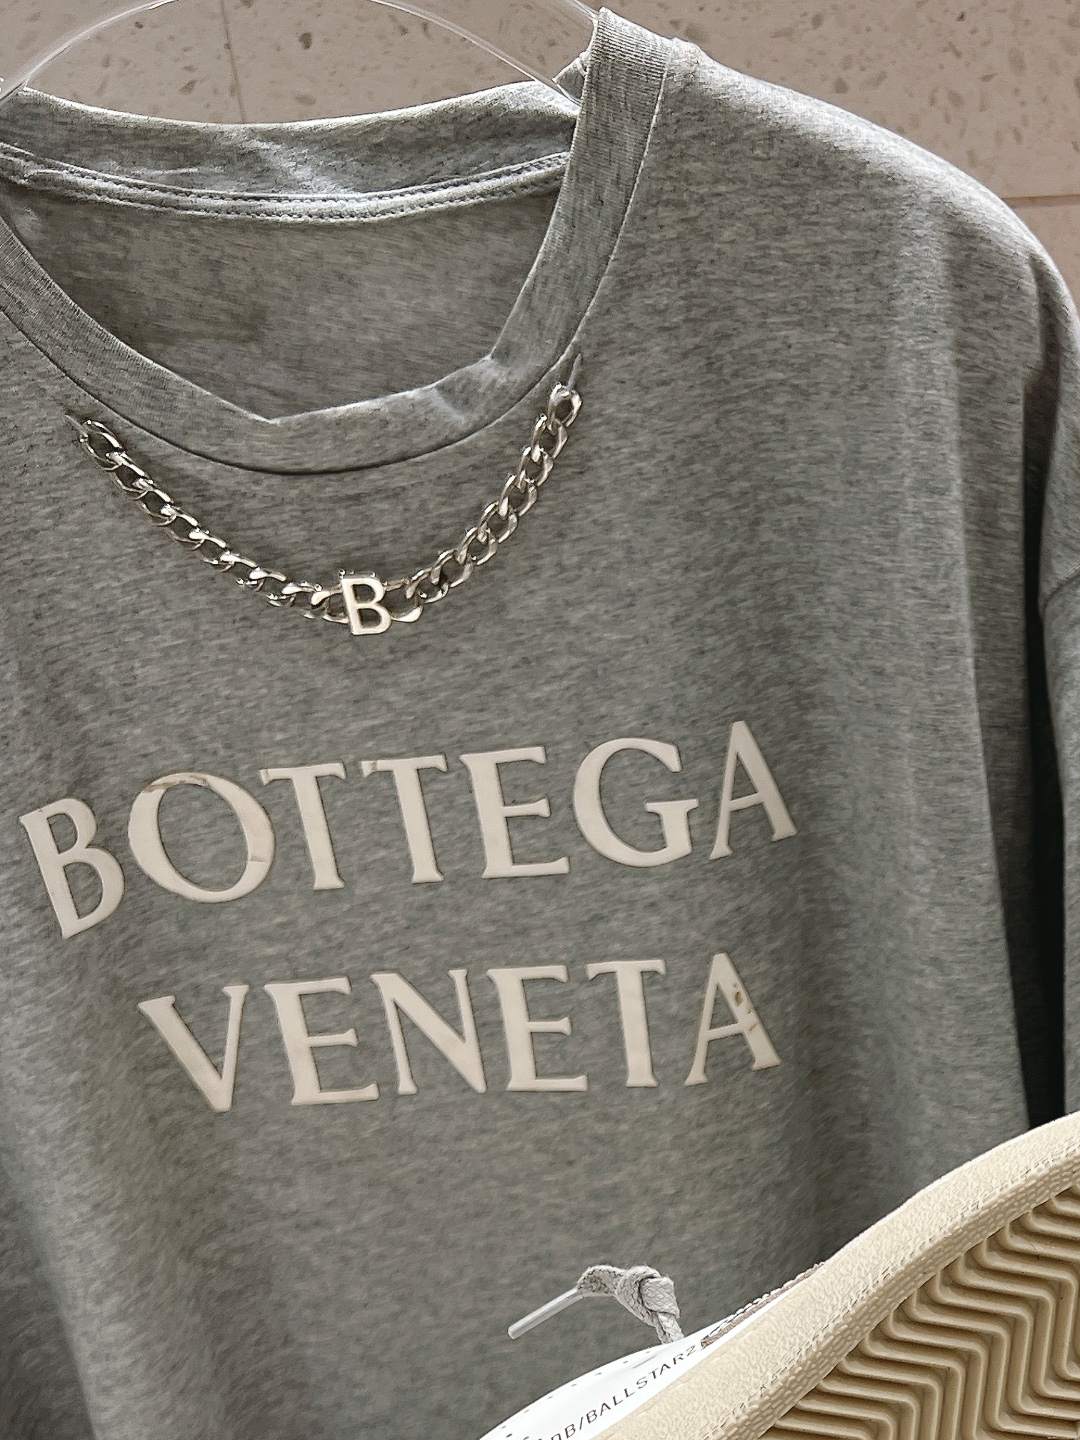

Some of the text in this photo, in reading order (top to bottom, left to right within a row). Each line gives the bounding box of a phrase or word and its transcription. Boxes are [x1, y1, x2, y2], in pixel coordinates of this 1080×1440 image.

[341, 577, 392, 635] B
[19, 721, 797, 940] BOTTEGA
[137, 952, 781, 1113] VENETA
